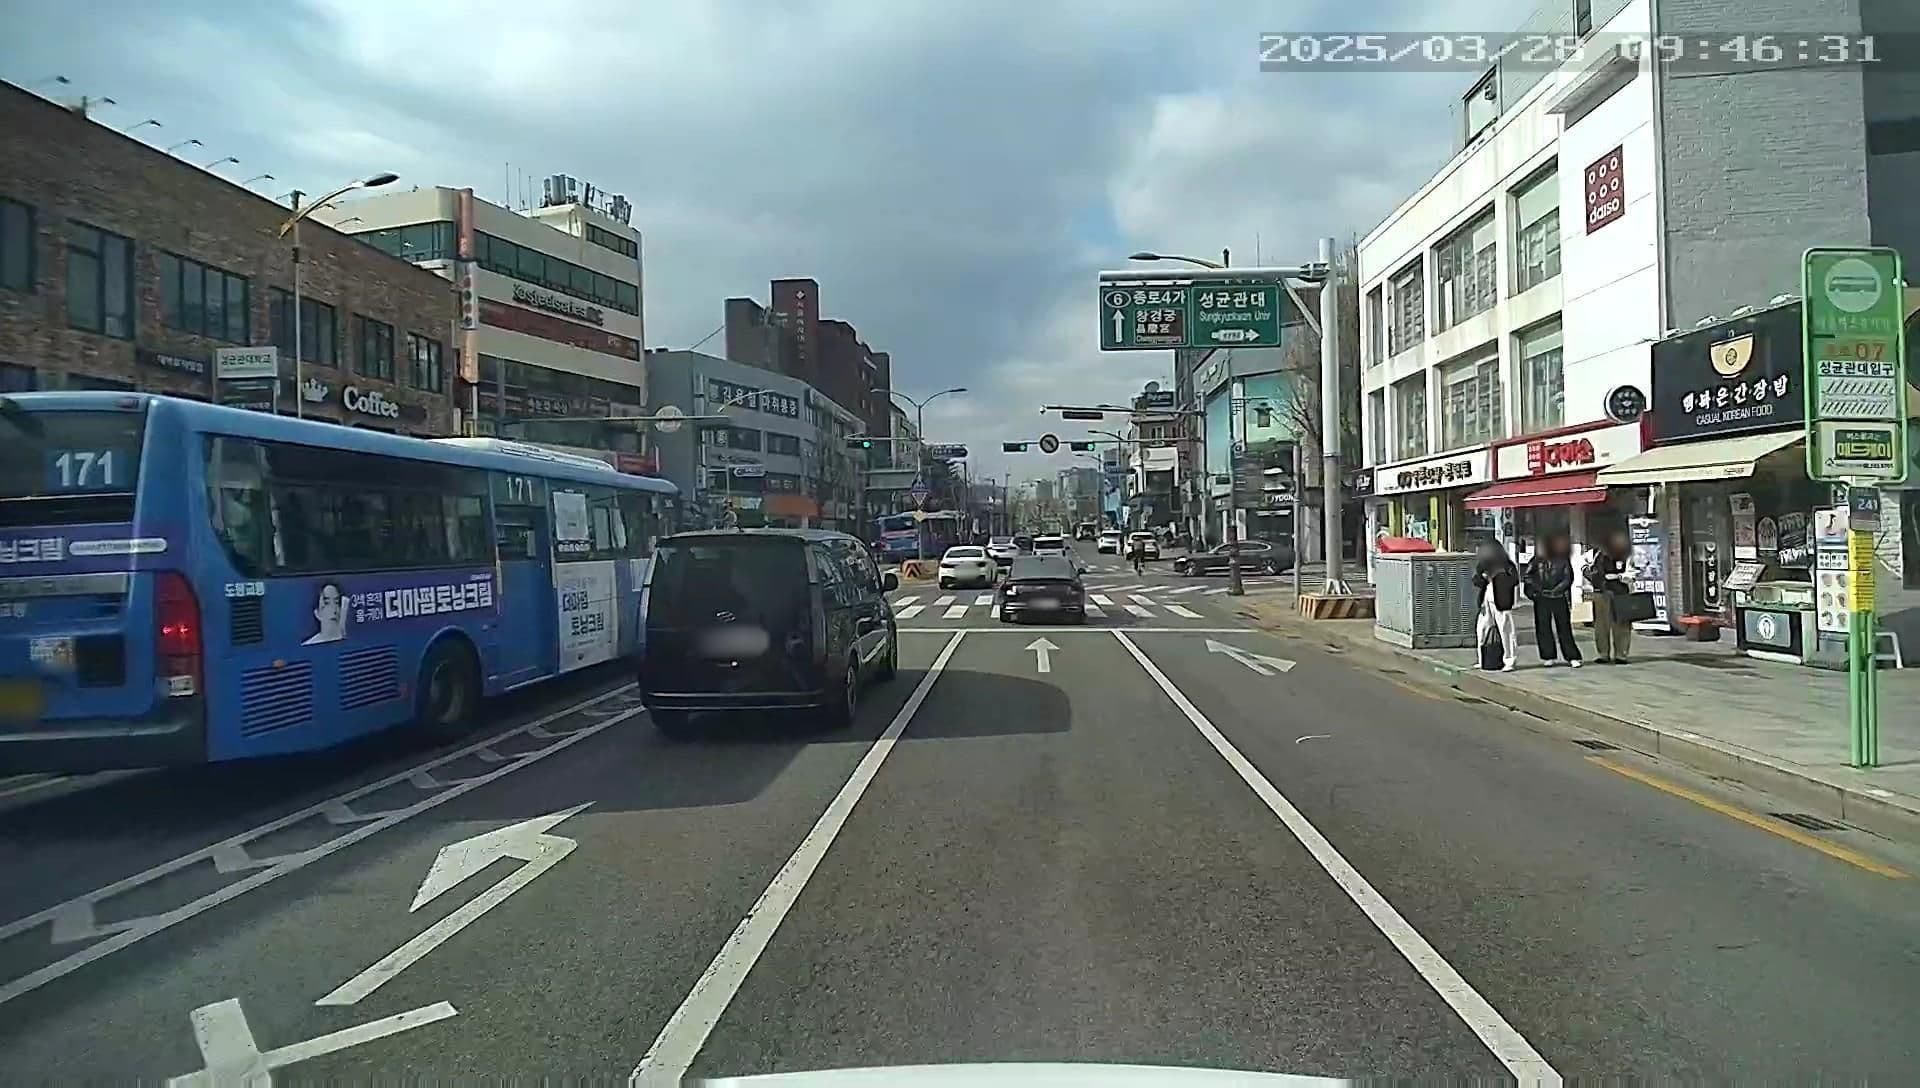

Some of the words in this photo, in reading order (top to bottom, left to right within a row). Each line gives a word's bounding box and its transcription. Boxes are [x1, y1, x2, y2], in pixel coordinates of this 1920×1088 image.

[1589, 198, 1620, 224] daiso
[1113, 293, 1123, 306] 6
[1133, 290, 1186, 305] 종로4가
[1199, 291, 1265, 309] 성균관대
[1136, 309, 1177, 323] 창경궁
[1820, 361, 1893, 375] 성균관대입구
[343, 386, 399, 418] Coffee
[1696, 411, 1721, 426] CASUAL
[1722, 407, 1751, 422] KOREAN
[1751, 404, 1773, 417] FOOD
[55, 451, 113, 487] 171
[506, 477, 533, 501] 171
